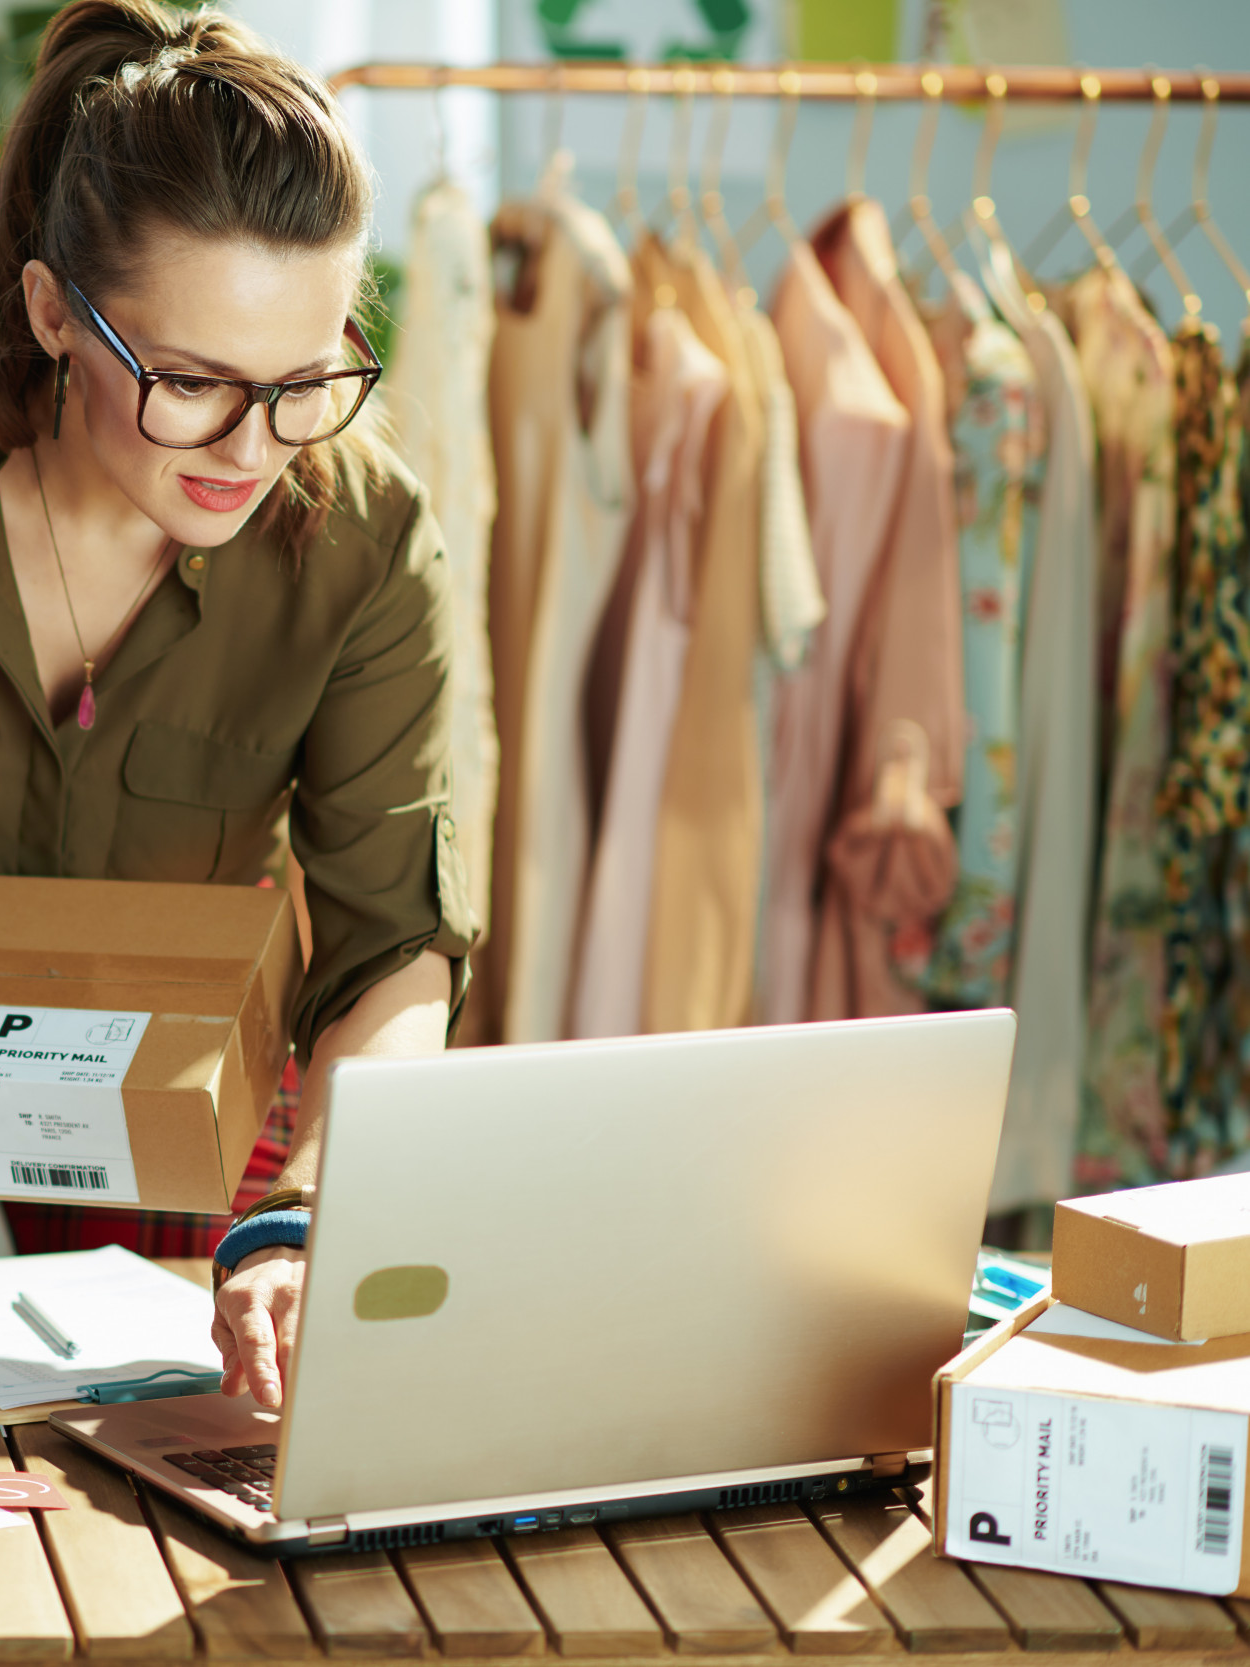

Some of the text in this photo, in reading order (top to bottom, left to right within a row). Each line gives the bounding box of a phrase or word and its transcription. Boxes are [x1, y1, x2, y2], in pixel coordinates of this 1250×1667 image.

[71, 1053, 108, 1063] MAIL
[10, 1160, 106, 1171] DELIVERY CONFIRMATION
[1034, 1418, 1052, 1540] PRIORITY MAIL
[969, 1511, 1011, 1546] P
